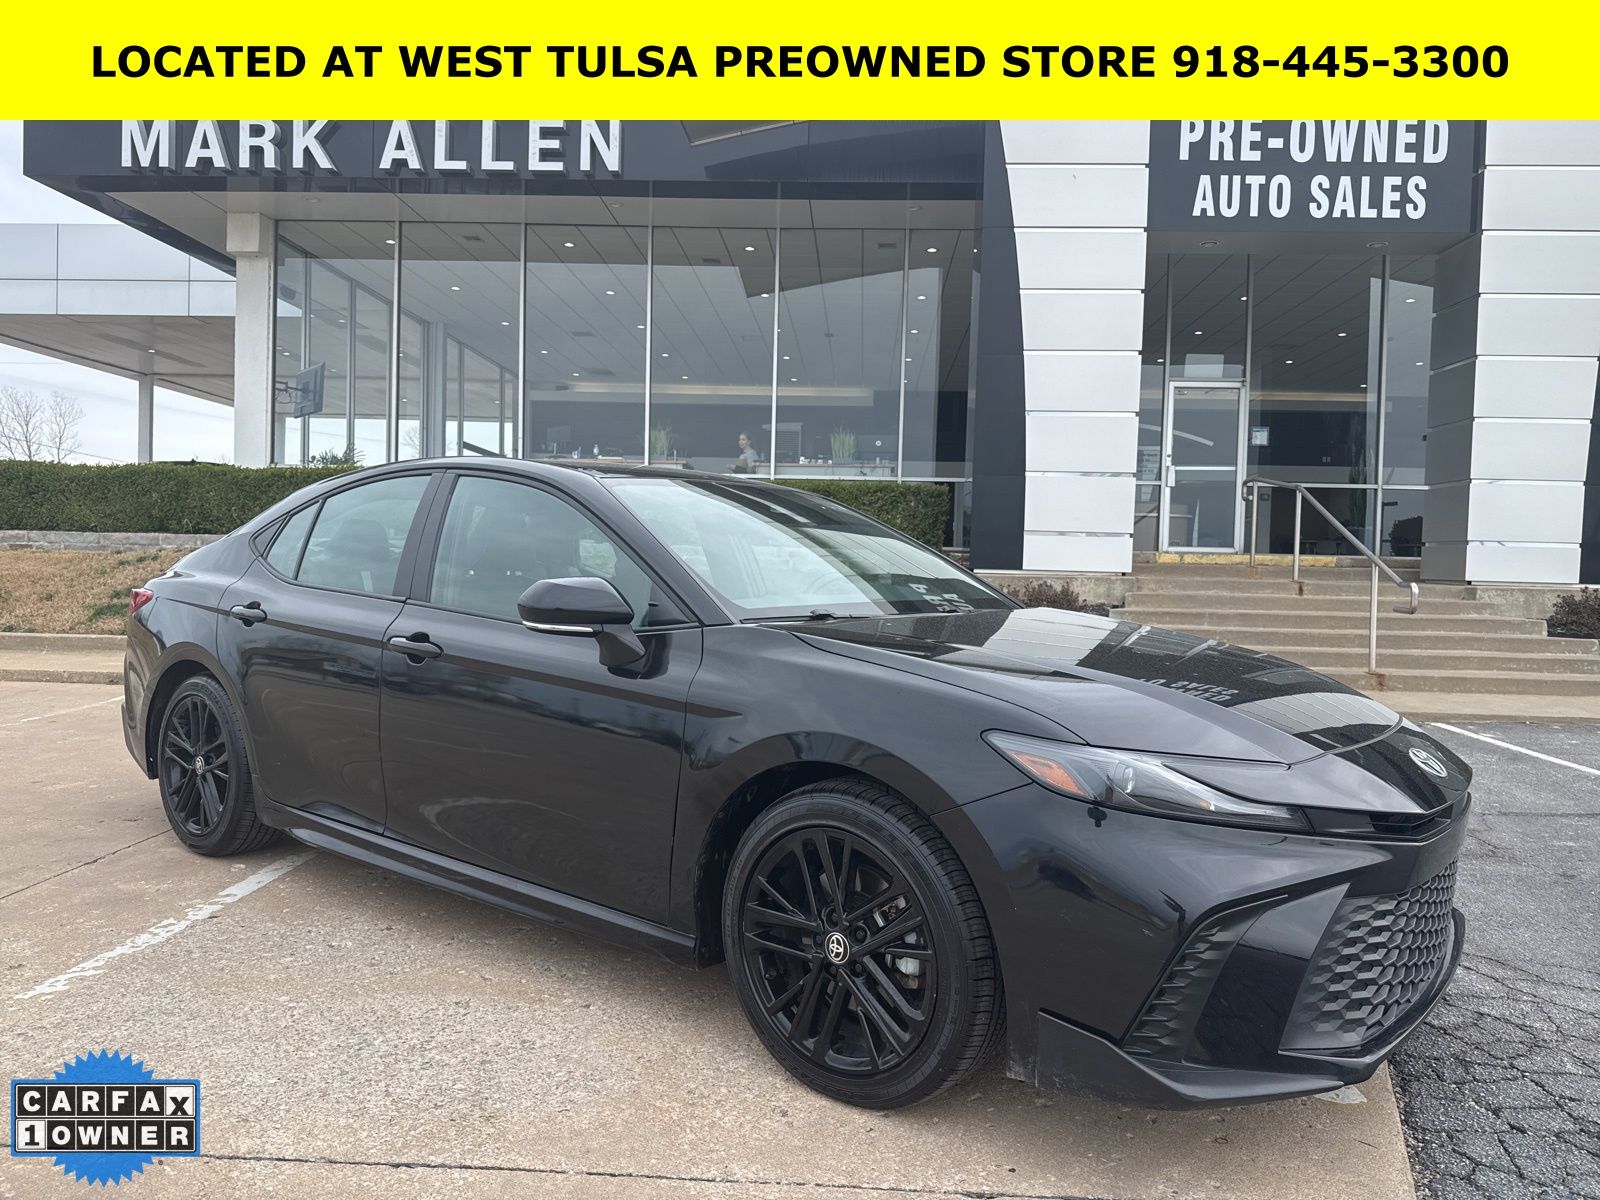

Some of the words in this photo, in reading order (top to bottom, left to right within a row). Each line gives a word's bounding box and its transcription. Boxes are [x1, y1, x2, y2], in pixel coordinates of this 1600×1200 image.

[121, 120, 335, 170] MARK
[379, 120, 621, 172] ALLEN
[1179, 120, 1450, 163] PRE-OWNED
[1192, 174, 1292, 218] AUTO
[1309, 175, 1427, 219] SALES
